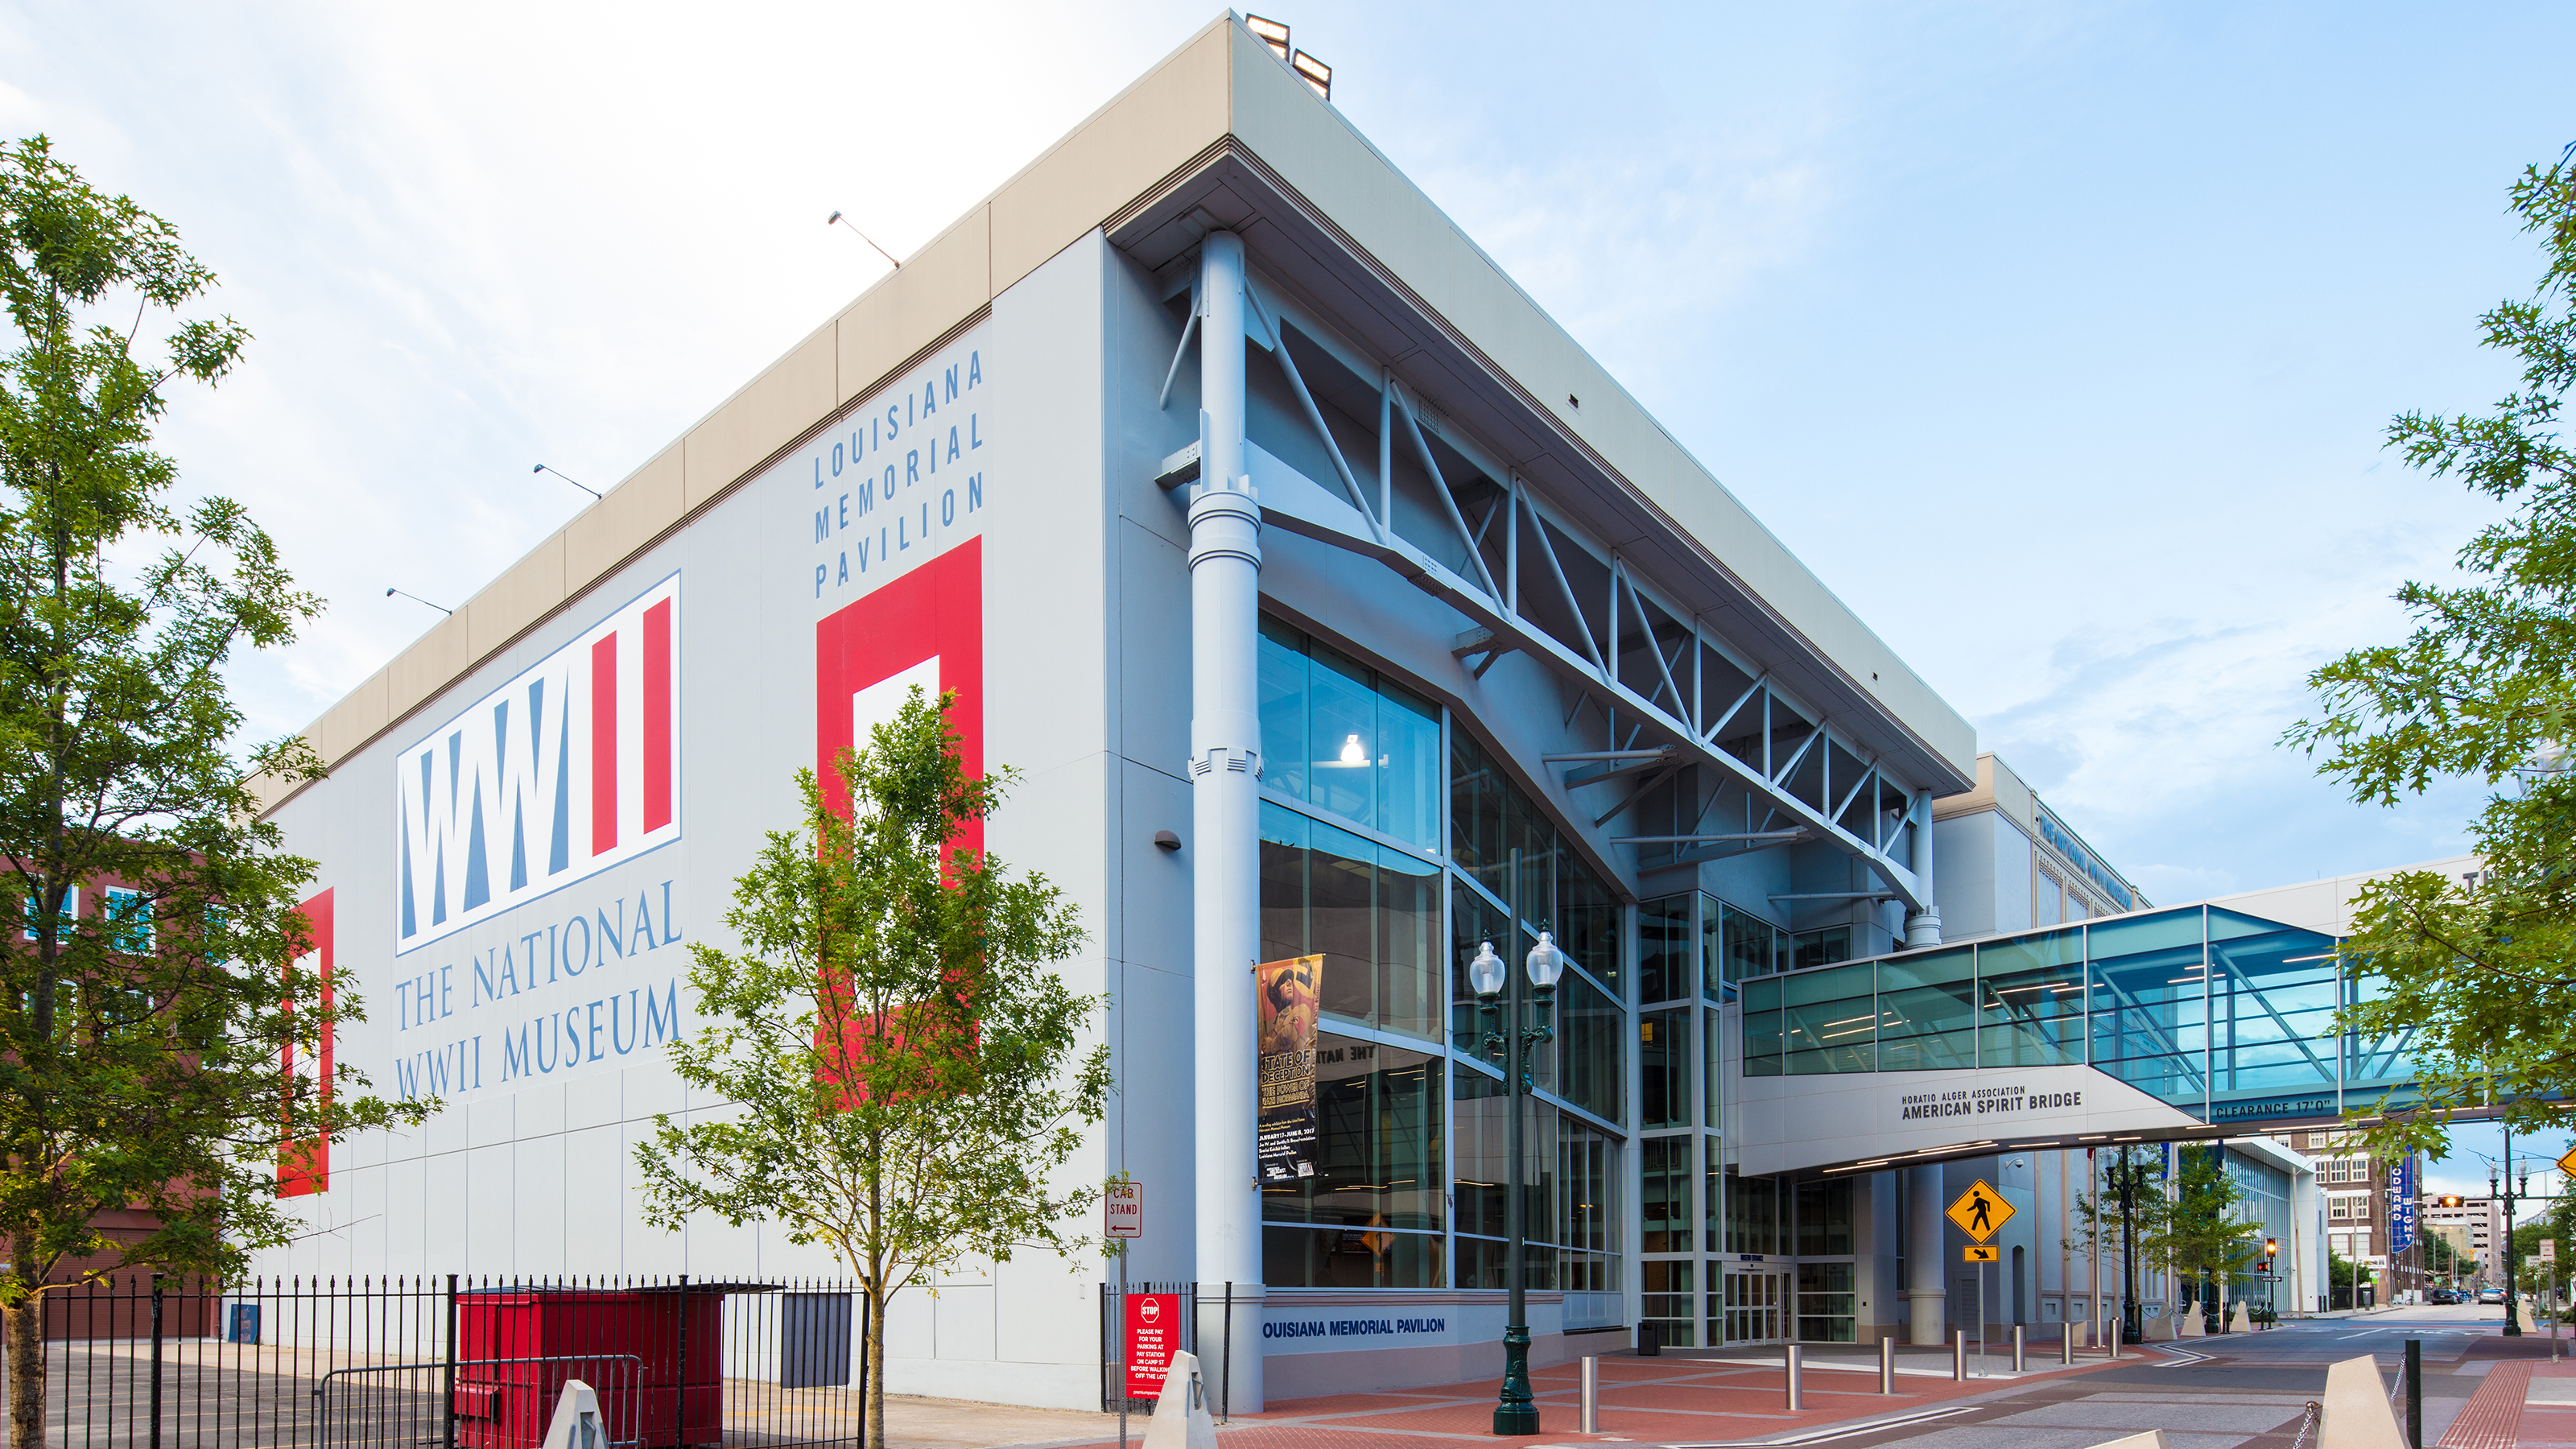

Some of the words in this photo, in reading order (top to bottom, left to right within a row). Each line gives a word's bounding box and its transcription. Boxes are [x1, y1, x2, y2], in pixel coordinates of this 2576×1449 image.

[815, 349, 982, 490] LOUISIANA
[815, 412, 982, 545] MEMORIAL
[815, 471, 982, 600] PAVILION
[398, 592, 676, 946] WWII
[2040, 814, 2055, 844] THE
[2056, 828, 2087, 873] NATIONAL
[395, 964, 453, 1032] THE
[472, 879, 683, 1008] NATIONAL
[395, 1034, 482, 1103] WWII
[501, 976, 683, 1083] MUSEUM
[1261, 1051, 1294, 1071] STATE
[1294, 1048, 1311, 1066] OF
[1261, 1063, 1311, 1084] DECEPTION
[1261, 1086, 1276, 1096] THE
[1277, 1081, 1298, 1096] POWER
[1298, 1080, 1310, 1091] OF
[1902, 1093, 1937, 1104] HORATIO
[1942, 1091, 1967, 1101] ALGER
[1972, 1085, 2025, 1099] ASSOCIATION
[1902, 1100, 1971, 1120] AMERICAN
[1977, 1096, 2024, 1114] SPIRIT
[2029, 1092, 2082, 1109] BRIDGE
[2216, 1103, 2289, 1119] CLEARANCE
[1113, 1188, 1134, 1199] CAB
[2392, 1160, 2402, 1221] ODWARD
[1110, 1203, 1137, 1215] STAND
[2403, 1197, 2413, 1241] WIGHT
[1142, 1306, 1158, 1315] STOP
[1262, 1321, 1326, 1339] OUISIANA
[1329, 1319, 1393, 1336] MEMORIAL
[1397, 1318, 1445, 1334] PAVILION
